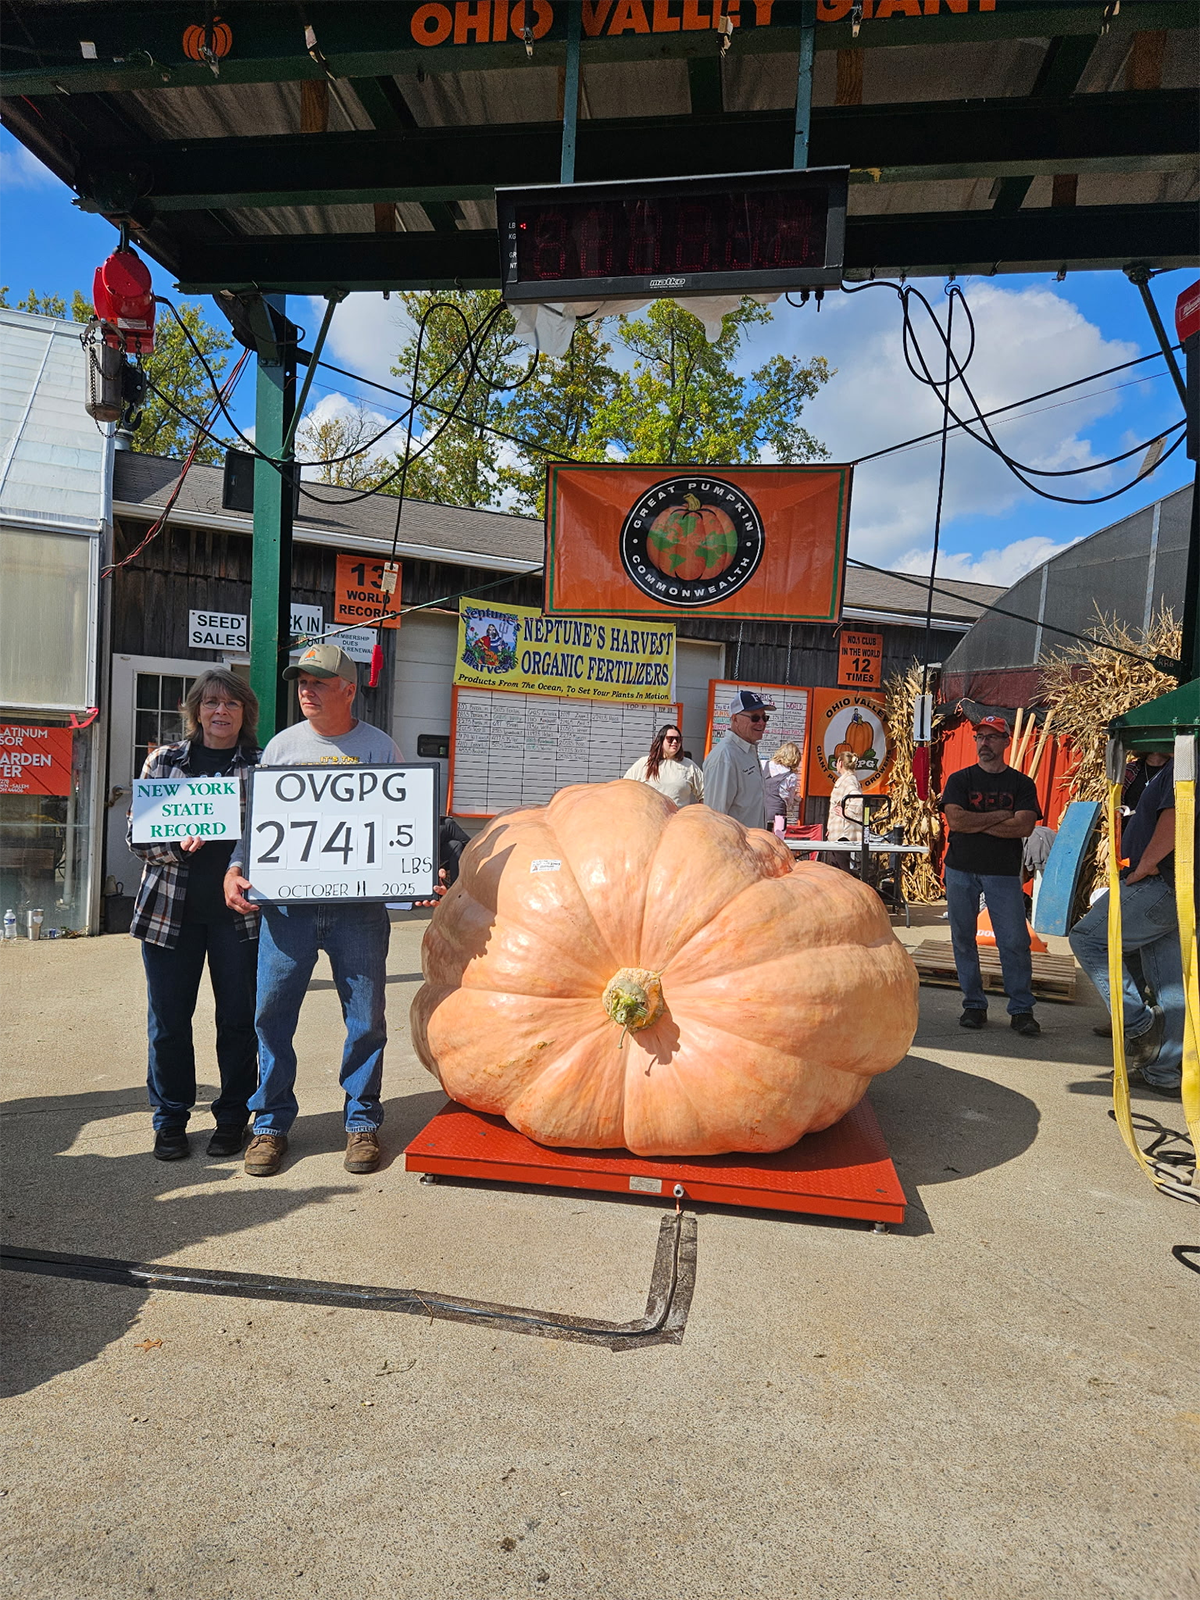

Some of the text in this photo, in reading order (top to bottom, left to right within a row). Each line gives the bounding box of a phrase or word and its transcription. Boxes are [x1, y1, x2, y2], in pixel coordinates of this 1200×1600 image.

[410, 0, 554, 47] OHIO
[649, 277, 686, 287] matko
[633, 482, 754, 532] GREAT PUMPKIN
[350, 563, 386, 589] 13
[632, 555, 750, 597] COMMONWEALTH
[346, 590, 391, 604] WORLD
[339, 604, 398, 620] RECORDS
[460, 607, 522, 632] Neptune's
[197, 614, 241, 630] SEED
[307, 616, 320, 633] IN
[192, 631, 247, 647] SALES
[523, 617, 674, 656] NEPTUNE'S HARVEST
[862, 637, 876, 646] CLUB
[842, 647, 880, 658] IN THE WORLD
[461, 650, 517, 674] Harvest
[521, 650, 669, 686] ORGANIC FERTILIZERS
[852, 658, 870, 672] 12
[846, 673, 874, 682] TIMES
[458, 674, 496, 686] Products
[498, 680, 519, 688] From
[538, 683, 564, 693] Ocean,
[578, 687, 591, 695] Set
[593, 689, 610, 697] Your
[611, 691, 634, 699] Plants
[826, 698, 850, 718] OHIO
[816, 745, 829, 772] GIANT
[138, 783, 236, 797] NEW YORK
[275, 772, 407, 802] OVGPG
[162, 803, 214, 817] STATE
[150, 822, 226, 837] RECORD
[401, 857, 432, 874] LBS
[278, 881, 416, 898] OCTOBER 11 2025
